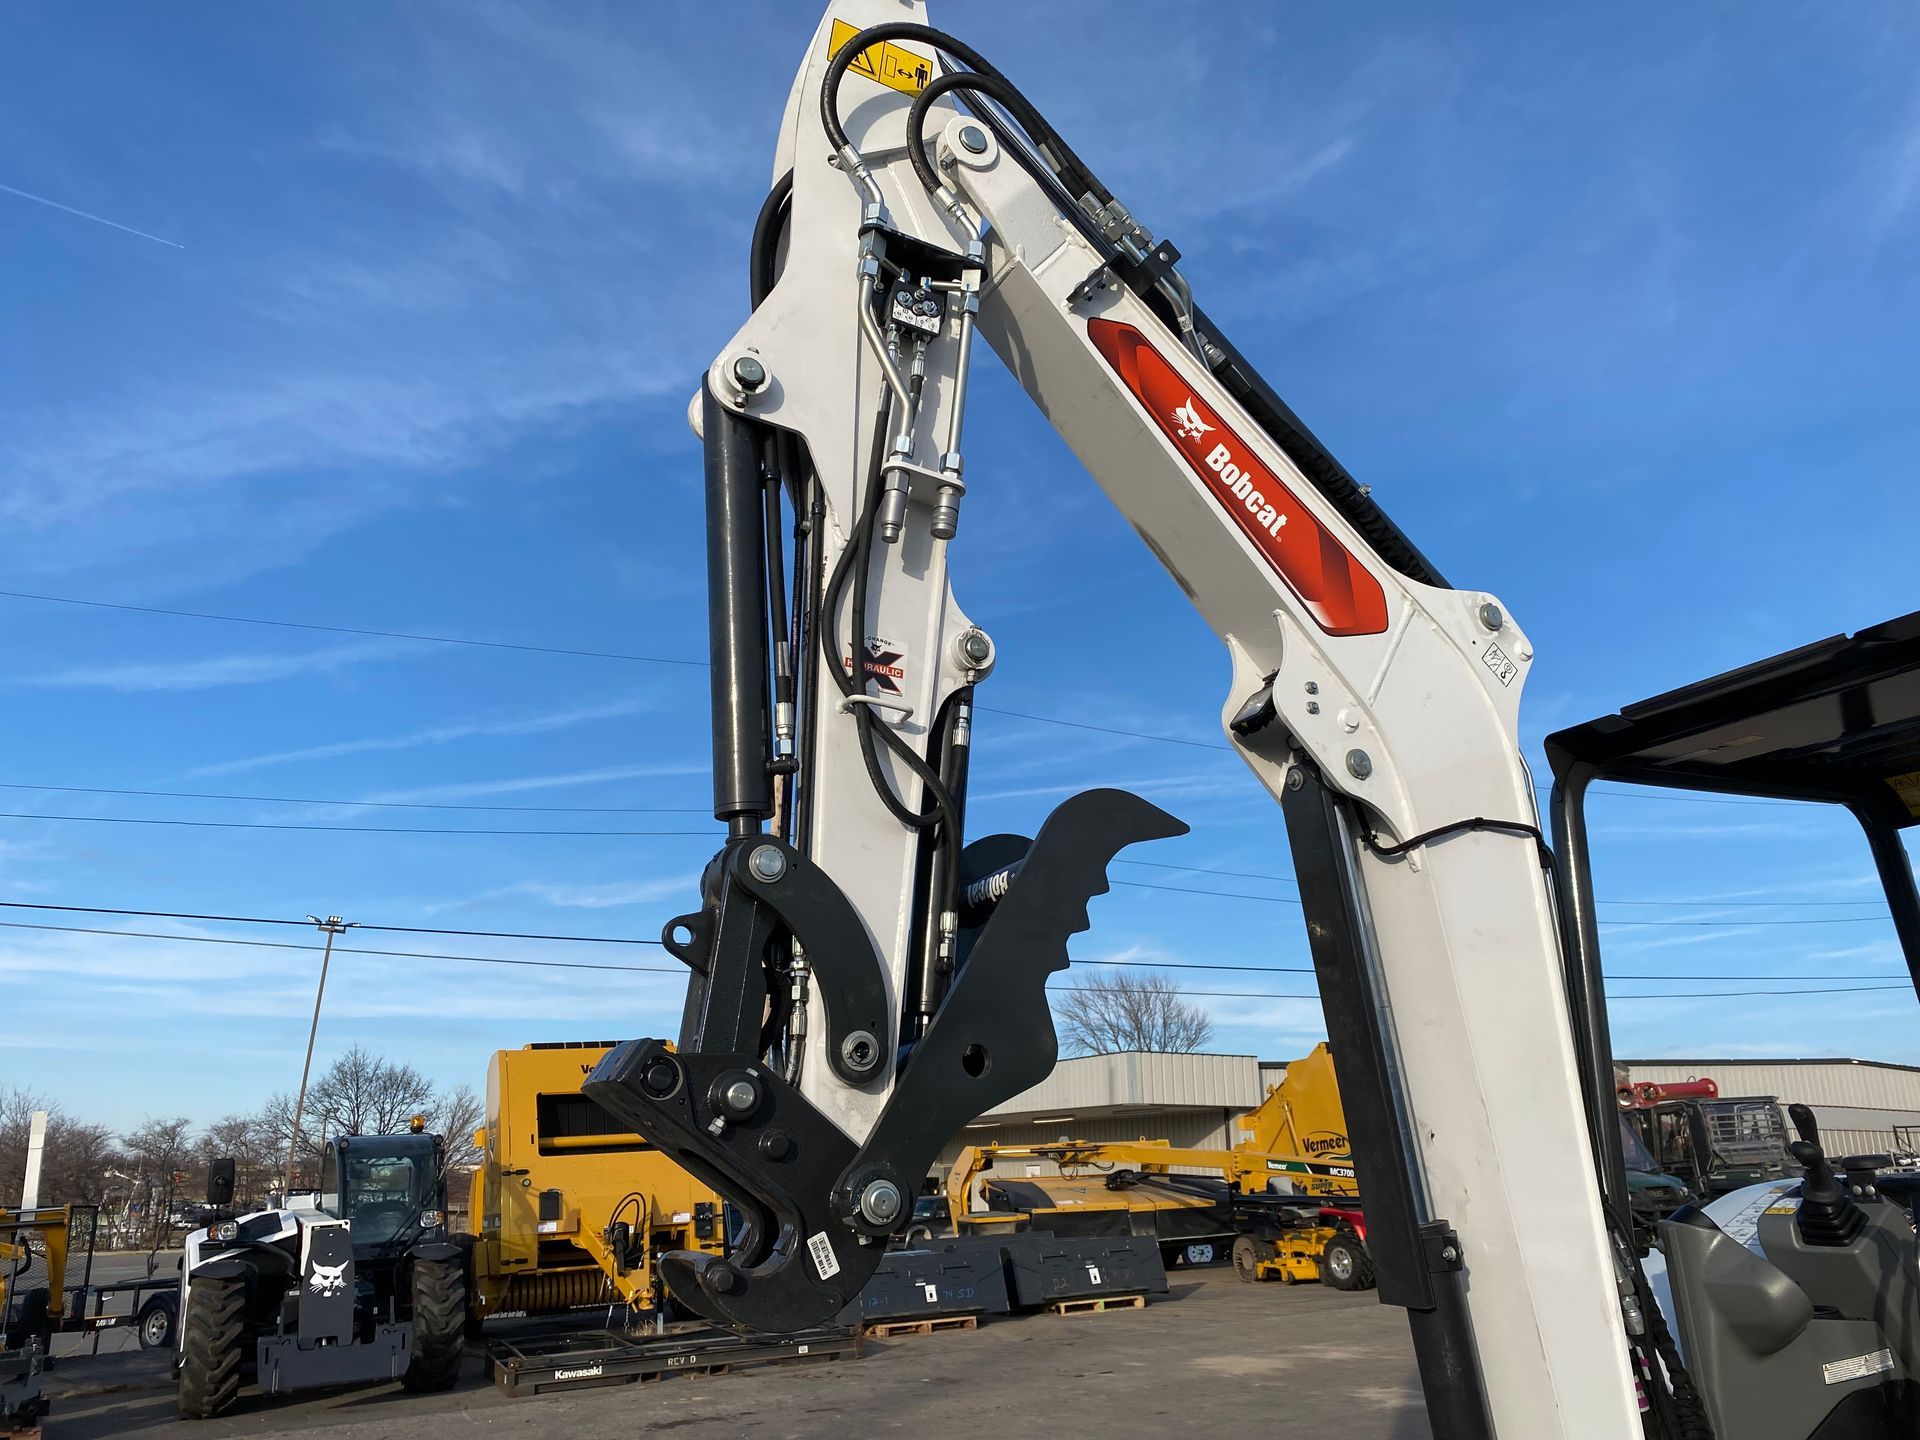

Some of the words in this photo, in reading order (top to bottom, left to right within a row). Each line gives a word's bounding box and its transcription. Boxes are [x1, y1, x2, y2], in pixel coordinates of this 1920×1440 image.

[1204, 442, 1288, 538] Bobcat
[847, 658, 902, 677] HRAULIC
[967, 870, 1009, 909] Bobcat
[1302, 1136, 1346, 1153] Vermeer
[1267, 1161, 1287, 1171] Vermeer
[1329, 1167, 1355, 1178] MC3700
[667, 1356, 685, 1367] REV
[690, 1355, 697, 1364] D
[554, 1366, 602, 1380] Kawasaki
